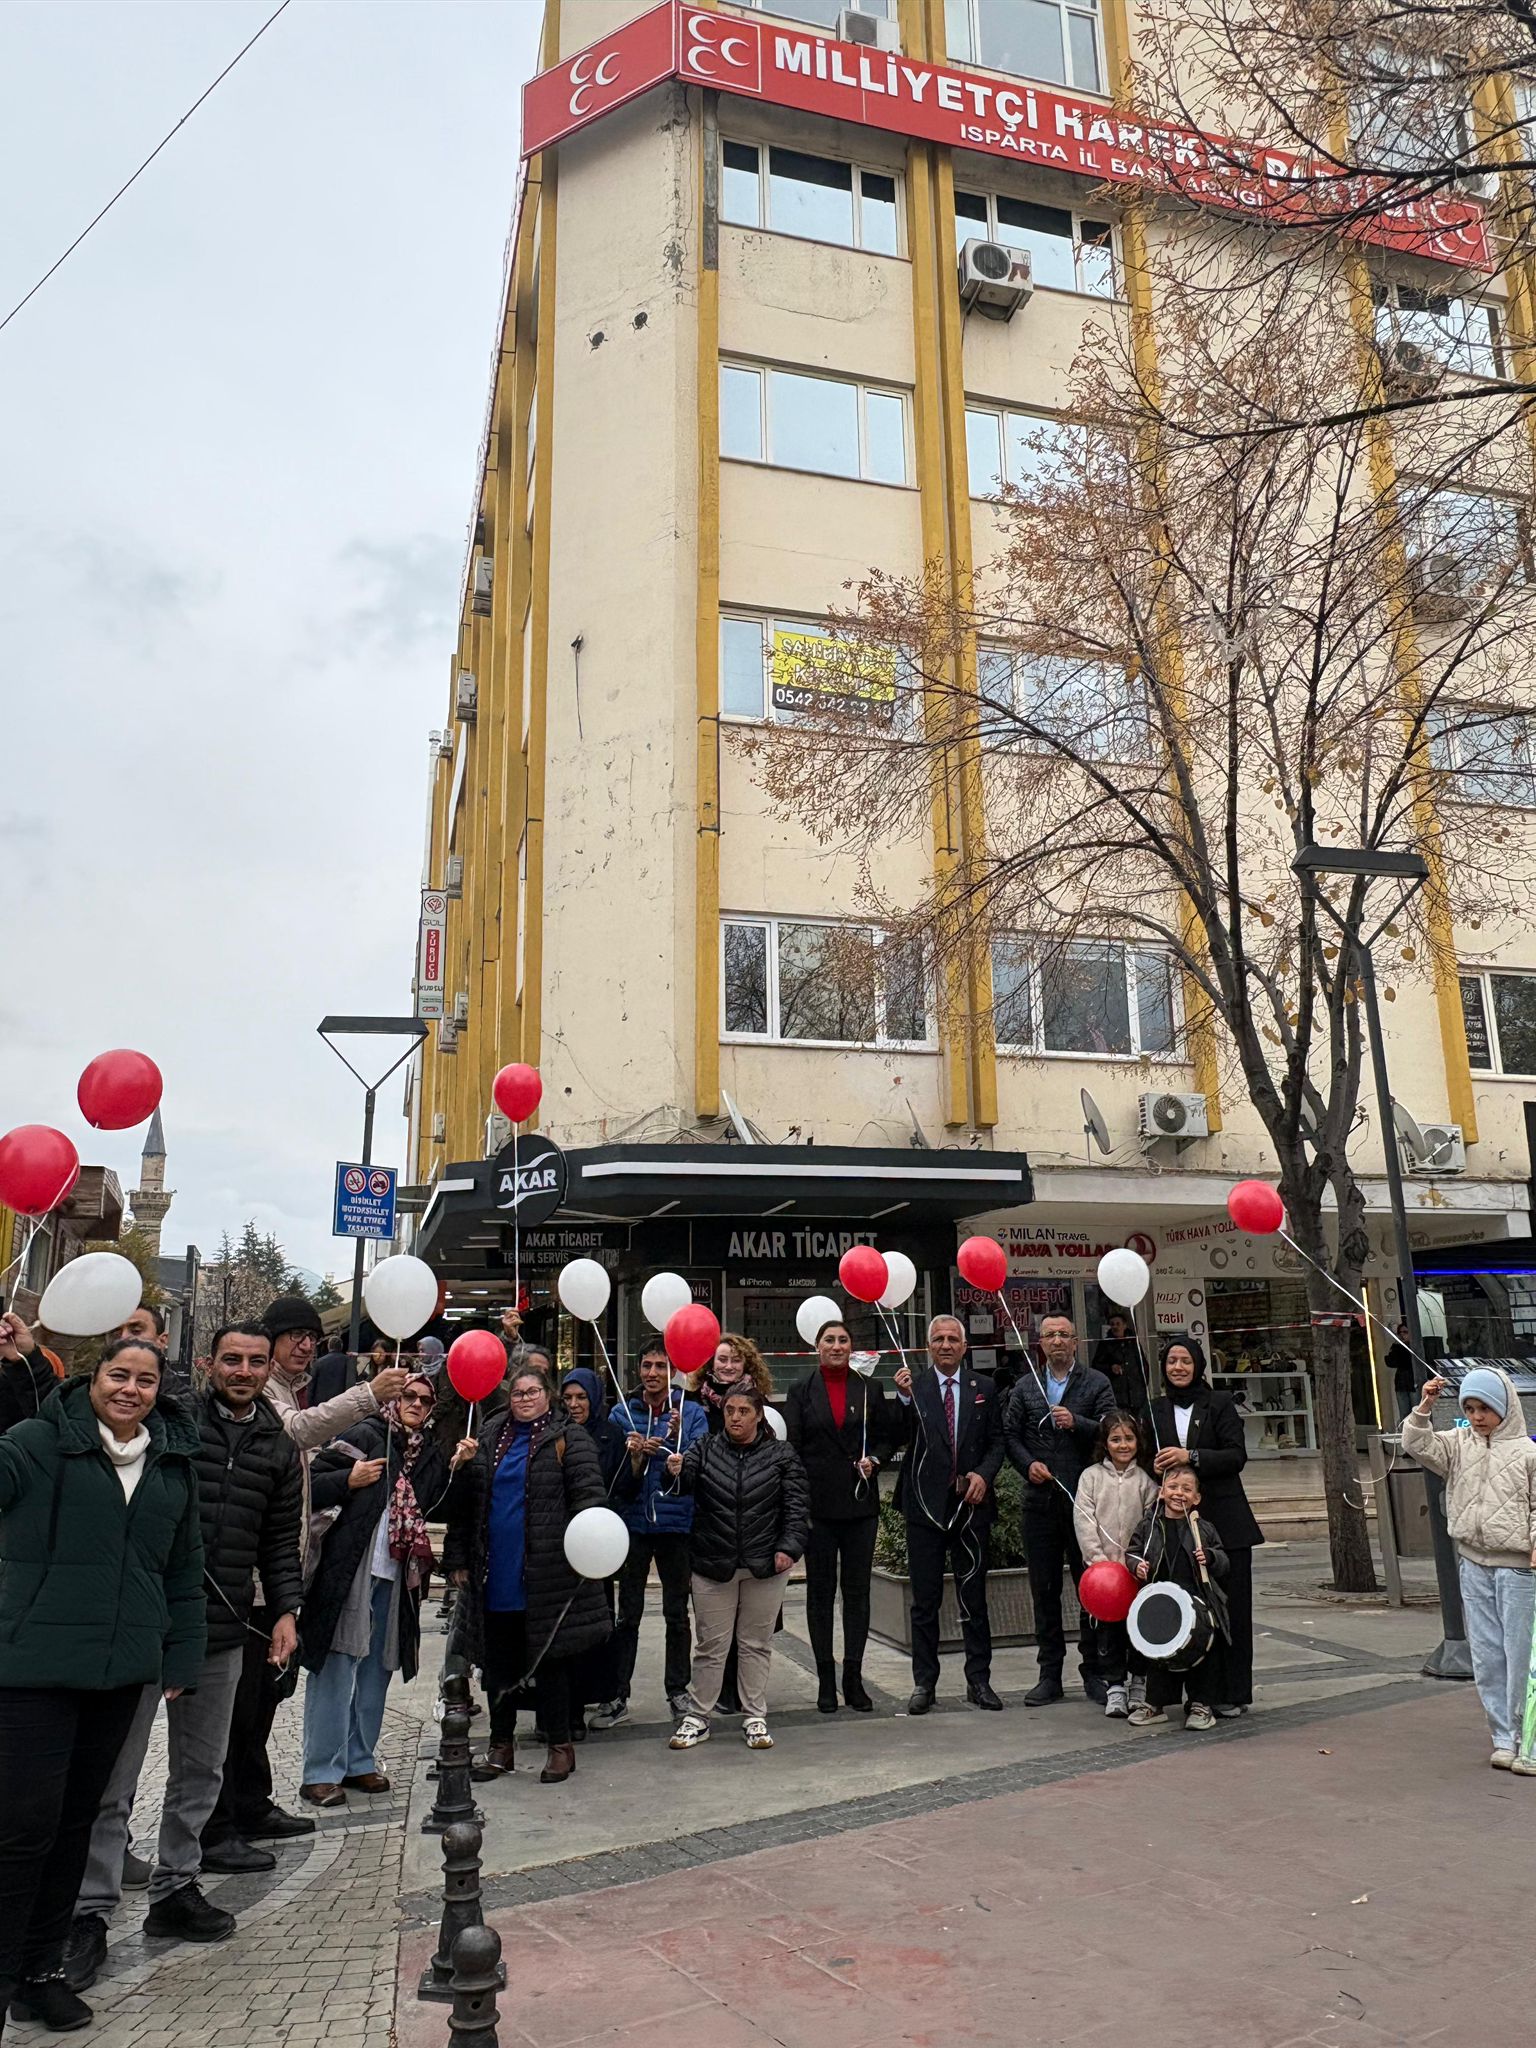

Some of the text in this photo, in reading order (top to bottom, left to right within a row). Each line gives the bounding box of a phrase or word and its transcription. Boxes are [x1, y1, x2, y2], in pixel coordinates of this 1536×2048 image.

[775, 36, 1039, 132] MİLLİYETÇİ
[960, 124, 1069, 162] ISPARTA
[1079, 147, 1101, 169] İL
[776, 689, 813, 706] 0542
[499, 1168, 557, 1193] AKAR
[343, 1214, 387, 1226] PARK ETMEK
[525, 1230, 604, 1247] AKAR TİCARET
[1010, 1228, 1090, 1240] MILAN TRAVEL
[1187, 1225, 1211, 1240] HAVA
[1213, 1220, 1239, 1235] YOLLA
[728, 1231, 786, 1258] AKAR
[1055, 1243, 1119, 1258] YOLLA
[537, 1249, 569, 1264] SERVİS
[959, 1286, 1065, 1304] UÇA BİLETİ
